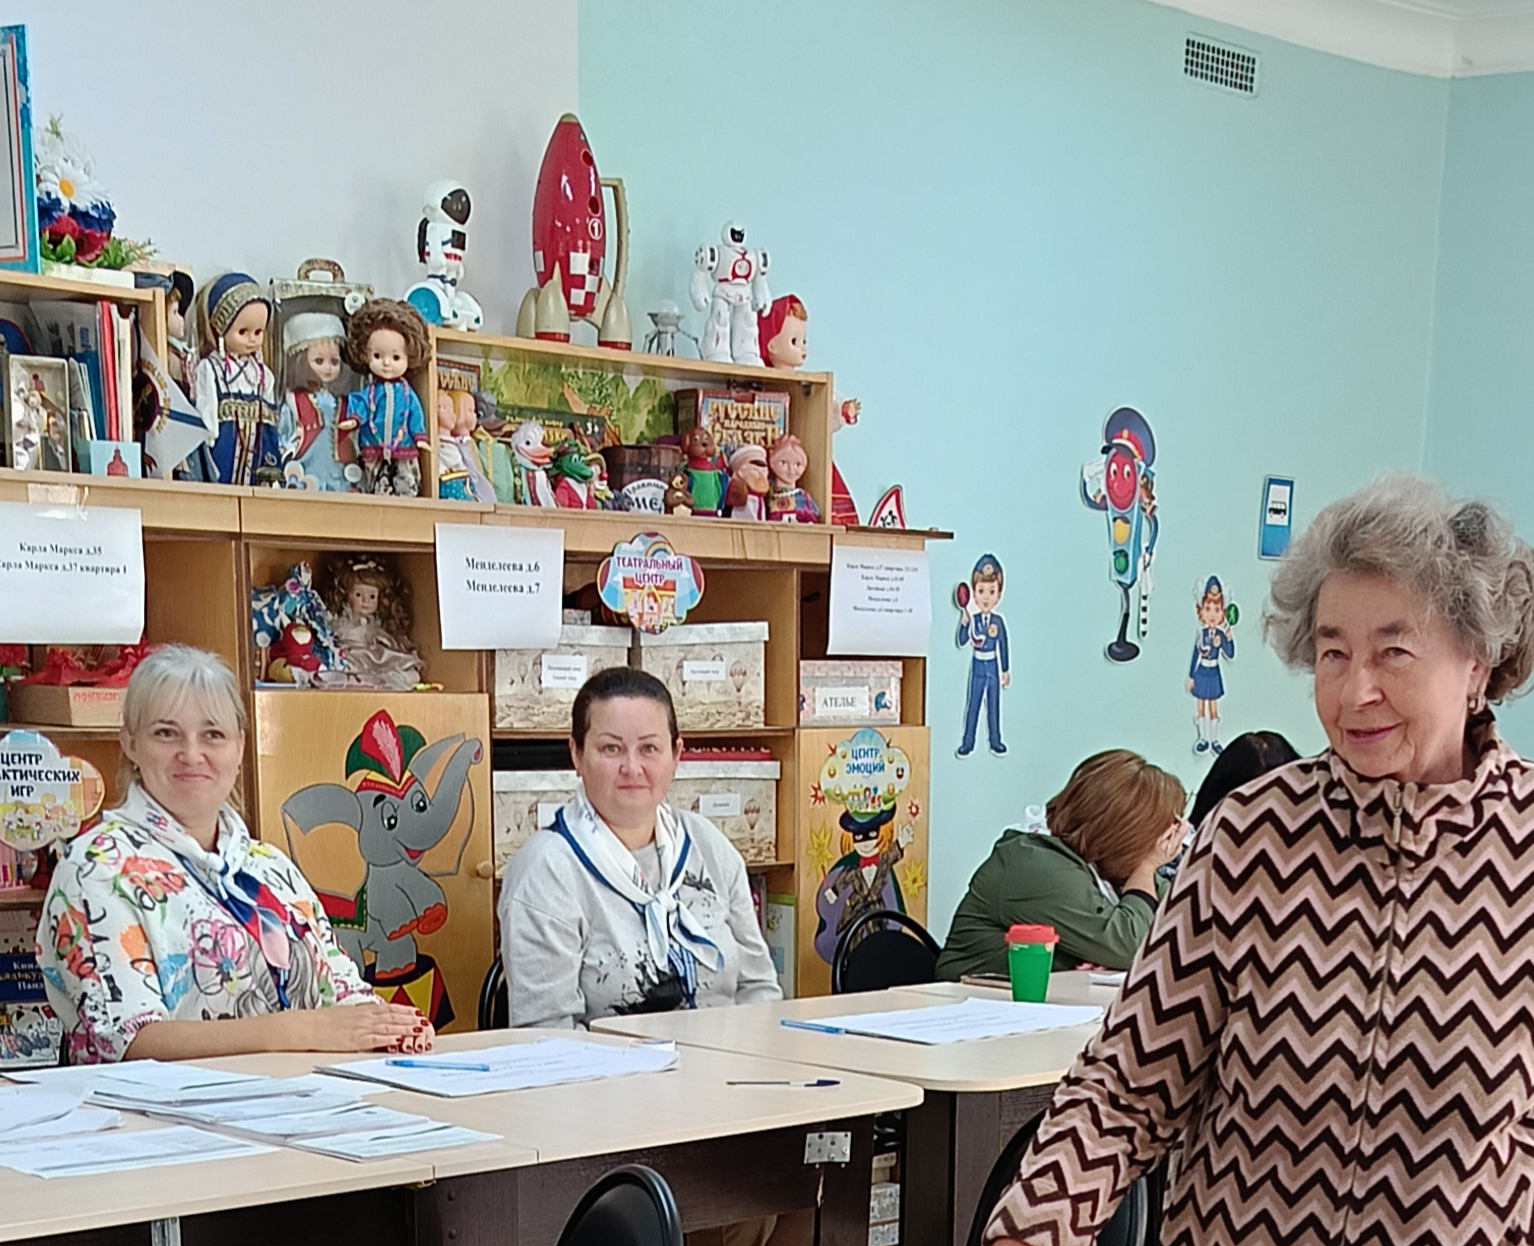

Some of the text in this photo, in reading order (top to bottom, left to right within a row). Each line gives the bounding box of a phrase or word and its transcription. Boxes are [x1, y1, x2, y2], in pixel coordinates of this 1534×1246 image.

[592, 220, 599, 237] 1
[19, 542, 48, 555] Карла
[50, 543, 83, 556] Маркса
[0, 559, 23, 571] арла
[25, 560, 59, 573] Маркса
[79, 563, 121, 576] квартира
[465, 557, 523, 572] Менделеева
[616, 556, 683, 571] ТЕАТРАЛЬНЫЙ
[635, 572, 665, 584] ЦЕНТР
[466, 579, 525, 594] Менделеева
[821, 696, 857, 708] АТЕЛЬЕ
[0, 752, 43, 767] ЦЕНТР
[851, 748, 880, 761] ЦЕНТР
[846, 759, 885, 775] ЭМОЦИЙ
[10, 785, 34, 797] ИГР
